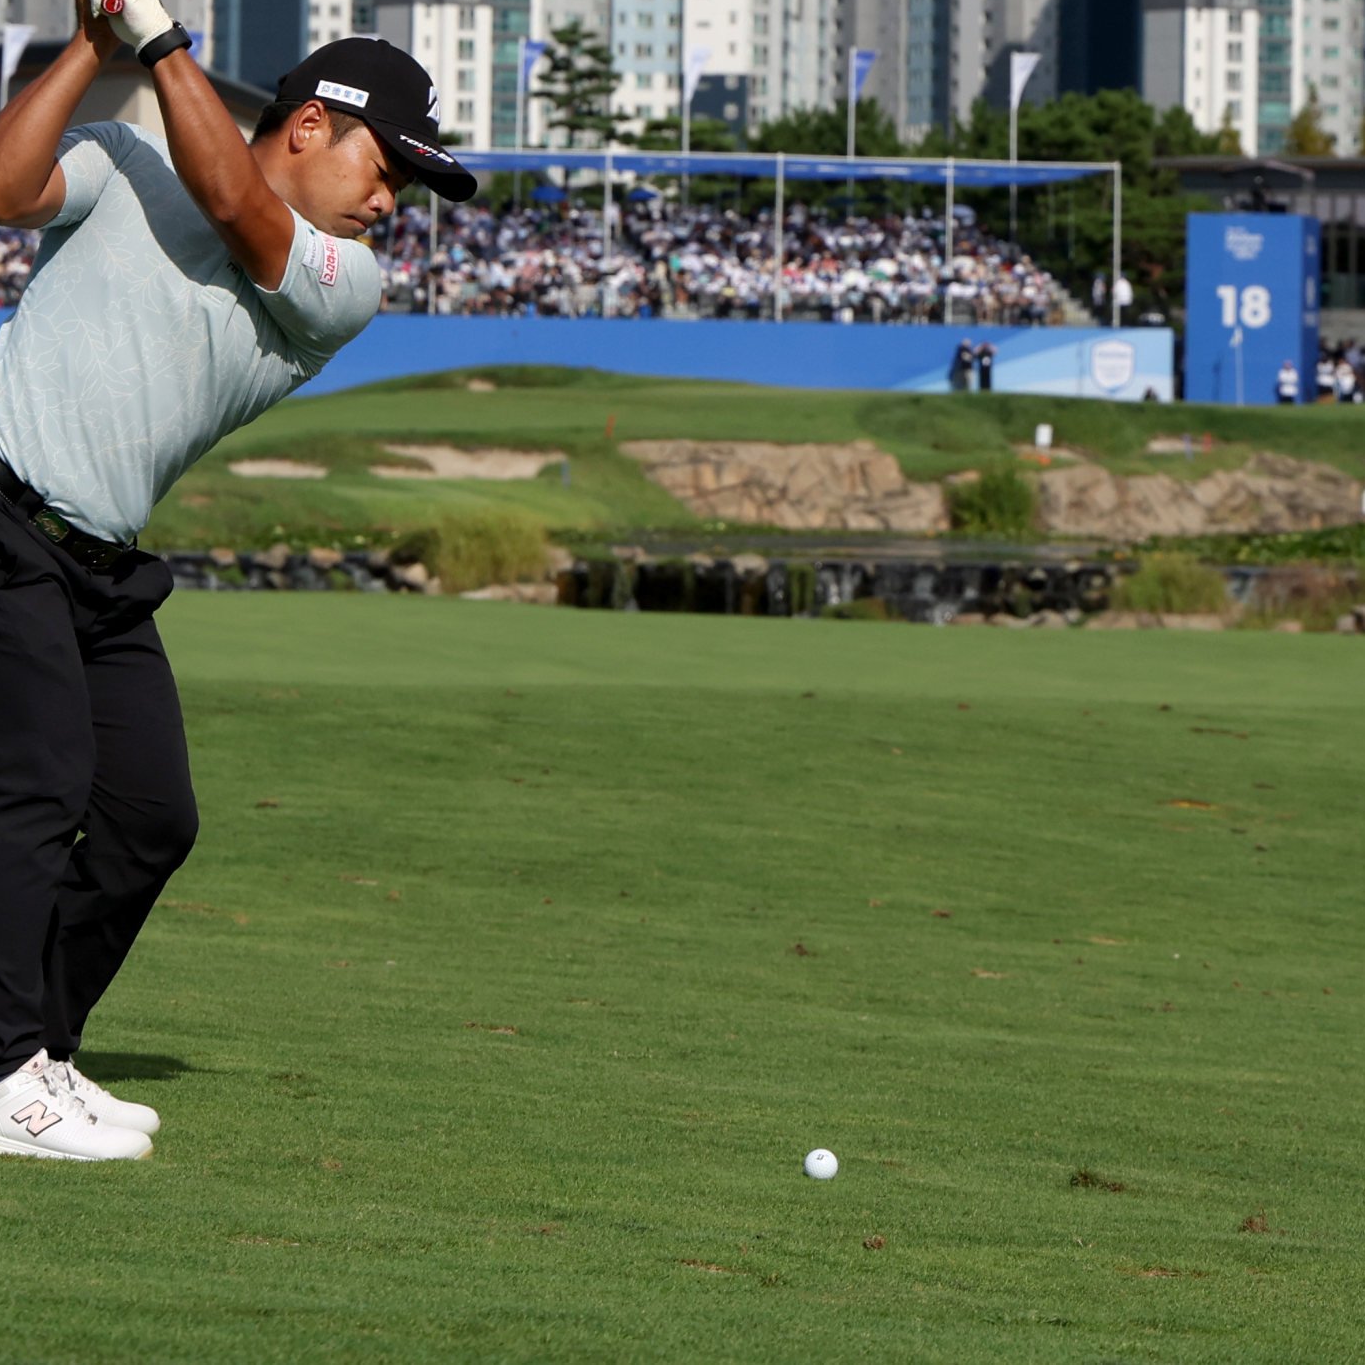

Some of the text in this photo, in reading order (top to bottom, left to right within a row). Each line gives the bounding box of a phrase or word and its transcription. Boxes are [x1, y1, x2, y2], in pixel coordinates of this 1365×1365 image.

[399, 134, 438, 154] TOUR
[1216, 285, 1271, 328] 18
[11, 1099, 63, 1138] N
